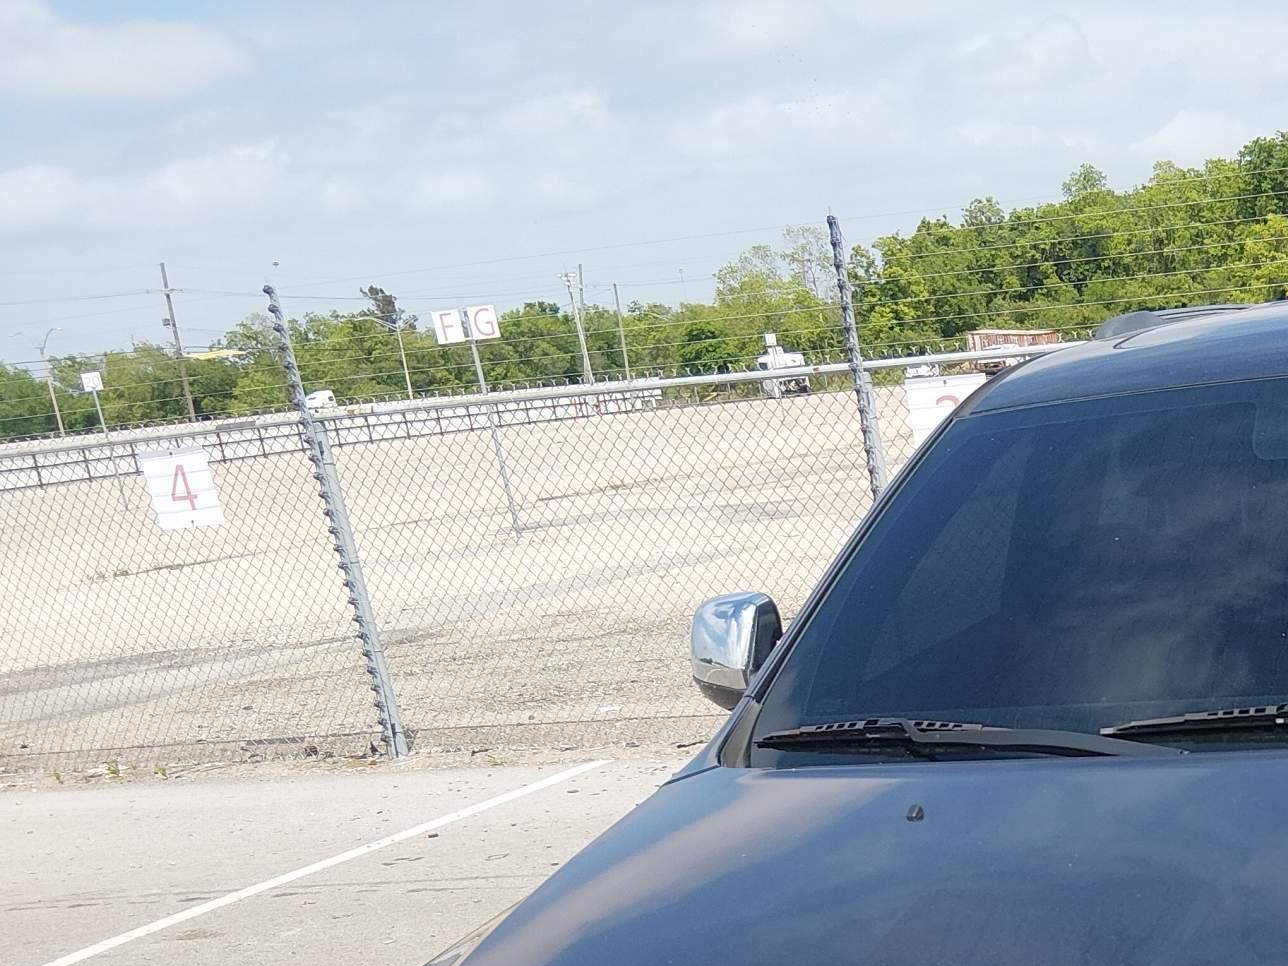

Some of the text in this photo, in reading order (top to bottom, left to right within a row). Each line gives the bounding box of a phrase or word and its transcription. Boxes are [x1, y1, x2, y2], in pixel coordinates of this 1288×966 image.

[439, 307, 496, 341] F G
[171, 464, 198, 511] 4
